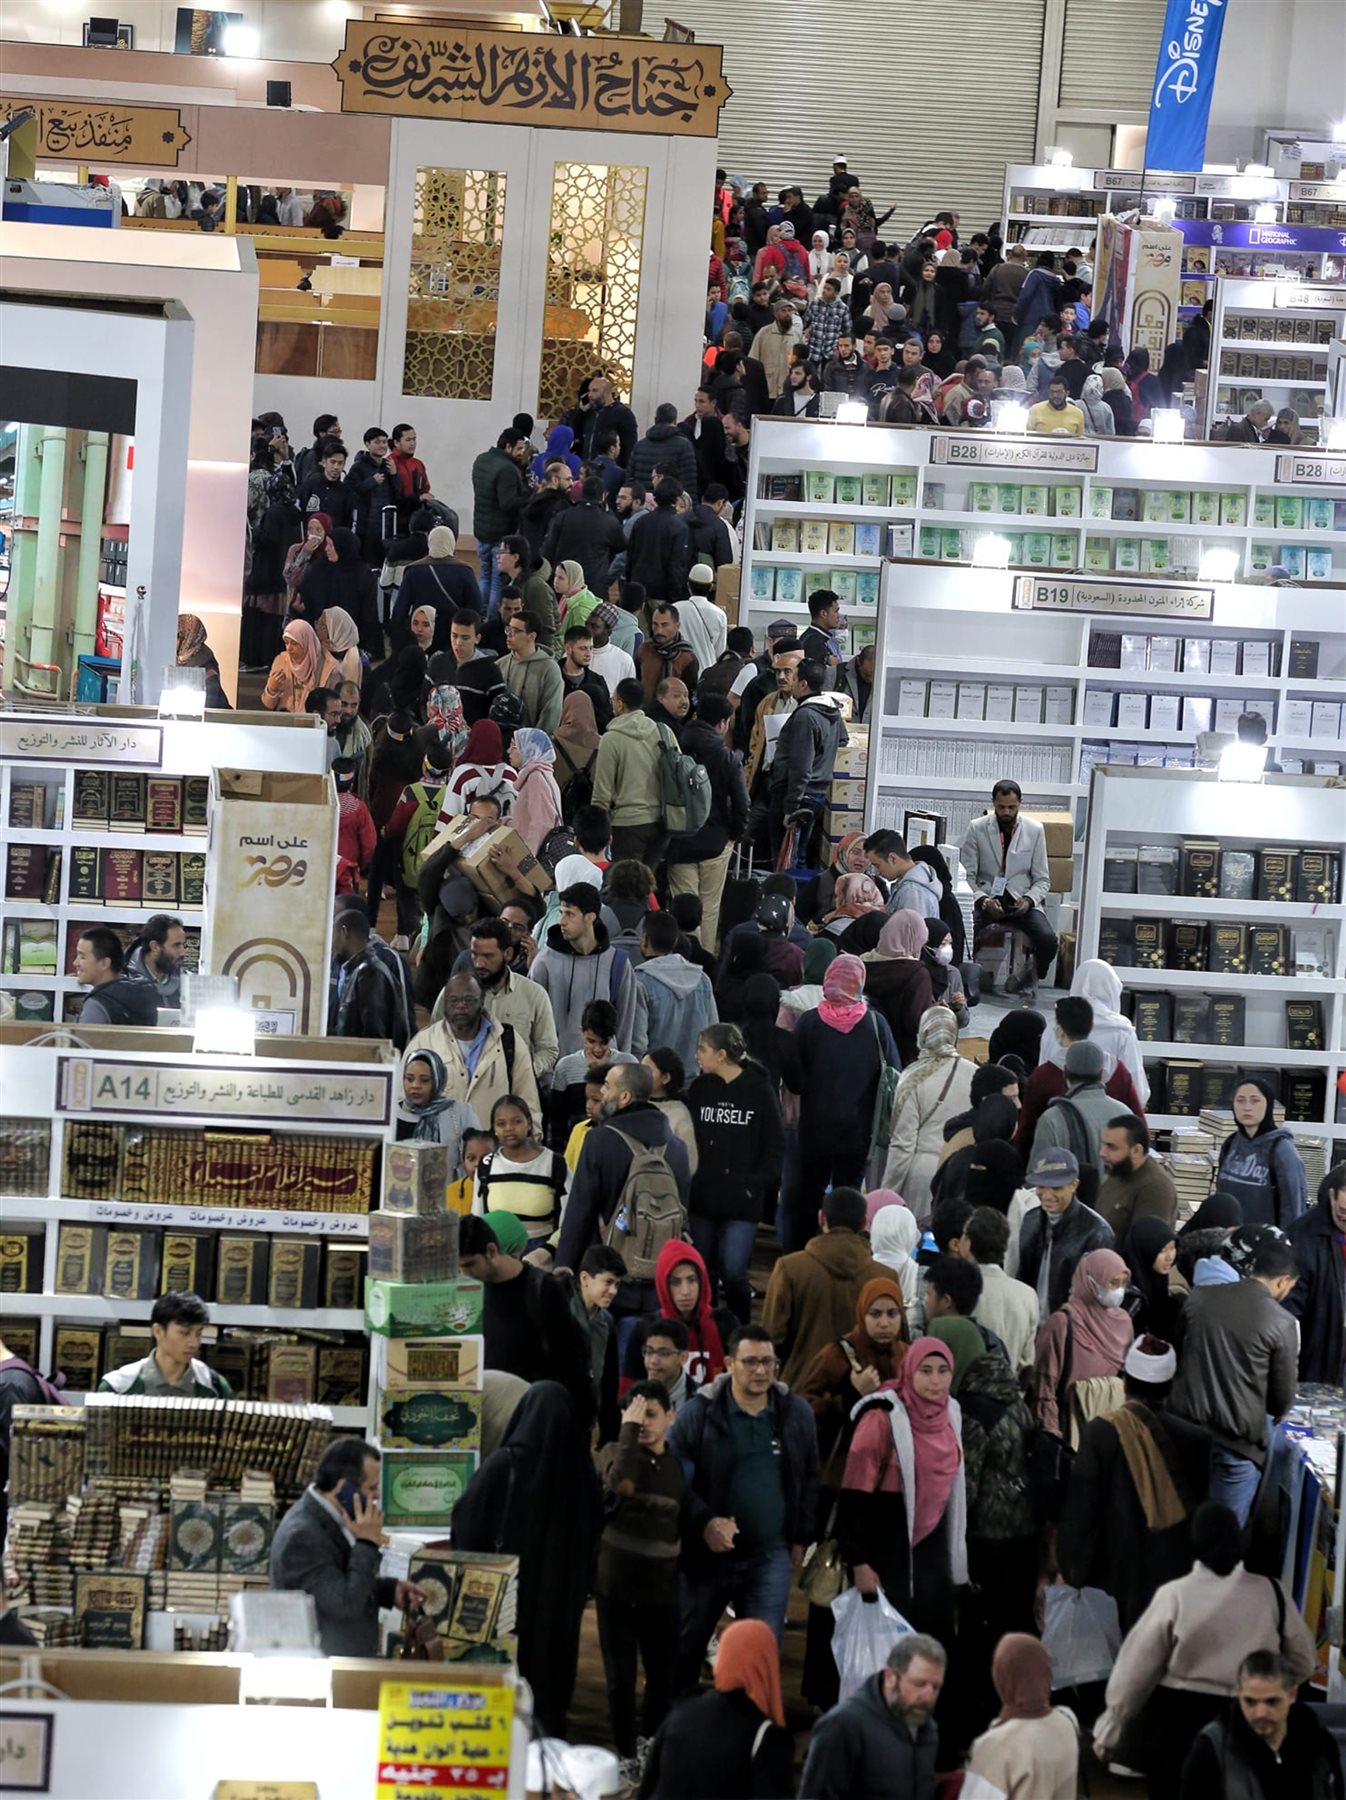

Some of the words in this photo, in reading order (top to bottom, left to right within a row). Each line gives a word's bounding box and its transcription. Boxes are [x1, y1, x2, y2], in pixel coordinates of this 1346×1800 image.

[361, 33, 500, 106] الشريف
[591, 50, 705, 122] جناح
[1105, 176, 1122, 186] B67
[1301, 188, 1317, 196] B67
[1260, 237, 1297, 245] GEOGRAPHIC
[1261, 230, 1290, 238] NATIONAL
[950, 445, 978, 459] B28
[1295, 463, 1323, 477] B28
[1036, 587, 1069, 603] B19
[1186, 595, 1205, 609] شركة
[17, 732, 59, 751] والتوزيع
[60, 735, 88, 750] للنشر
[119, 737, 137, 751] دار
[239, 834, 275, 848] اسم
[236, 854, 308, 889] مصر
[96, 1074, 151, 1101] A14
[163, 1080, 206, 1105] والتوزيع
[207, 1081, 243, 1103] والنشر
[246, 1082, 283, 1103] للطباعة
[355, 1088, 375, 1106] دار
[700, 1106, 755, 1126] YOURSELF
